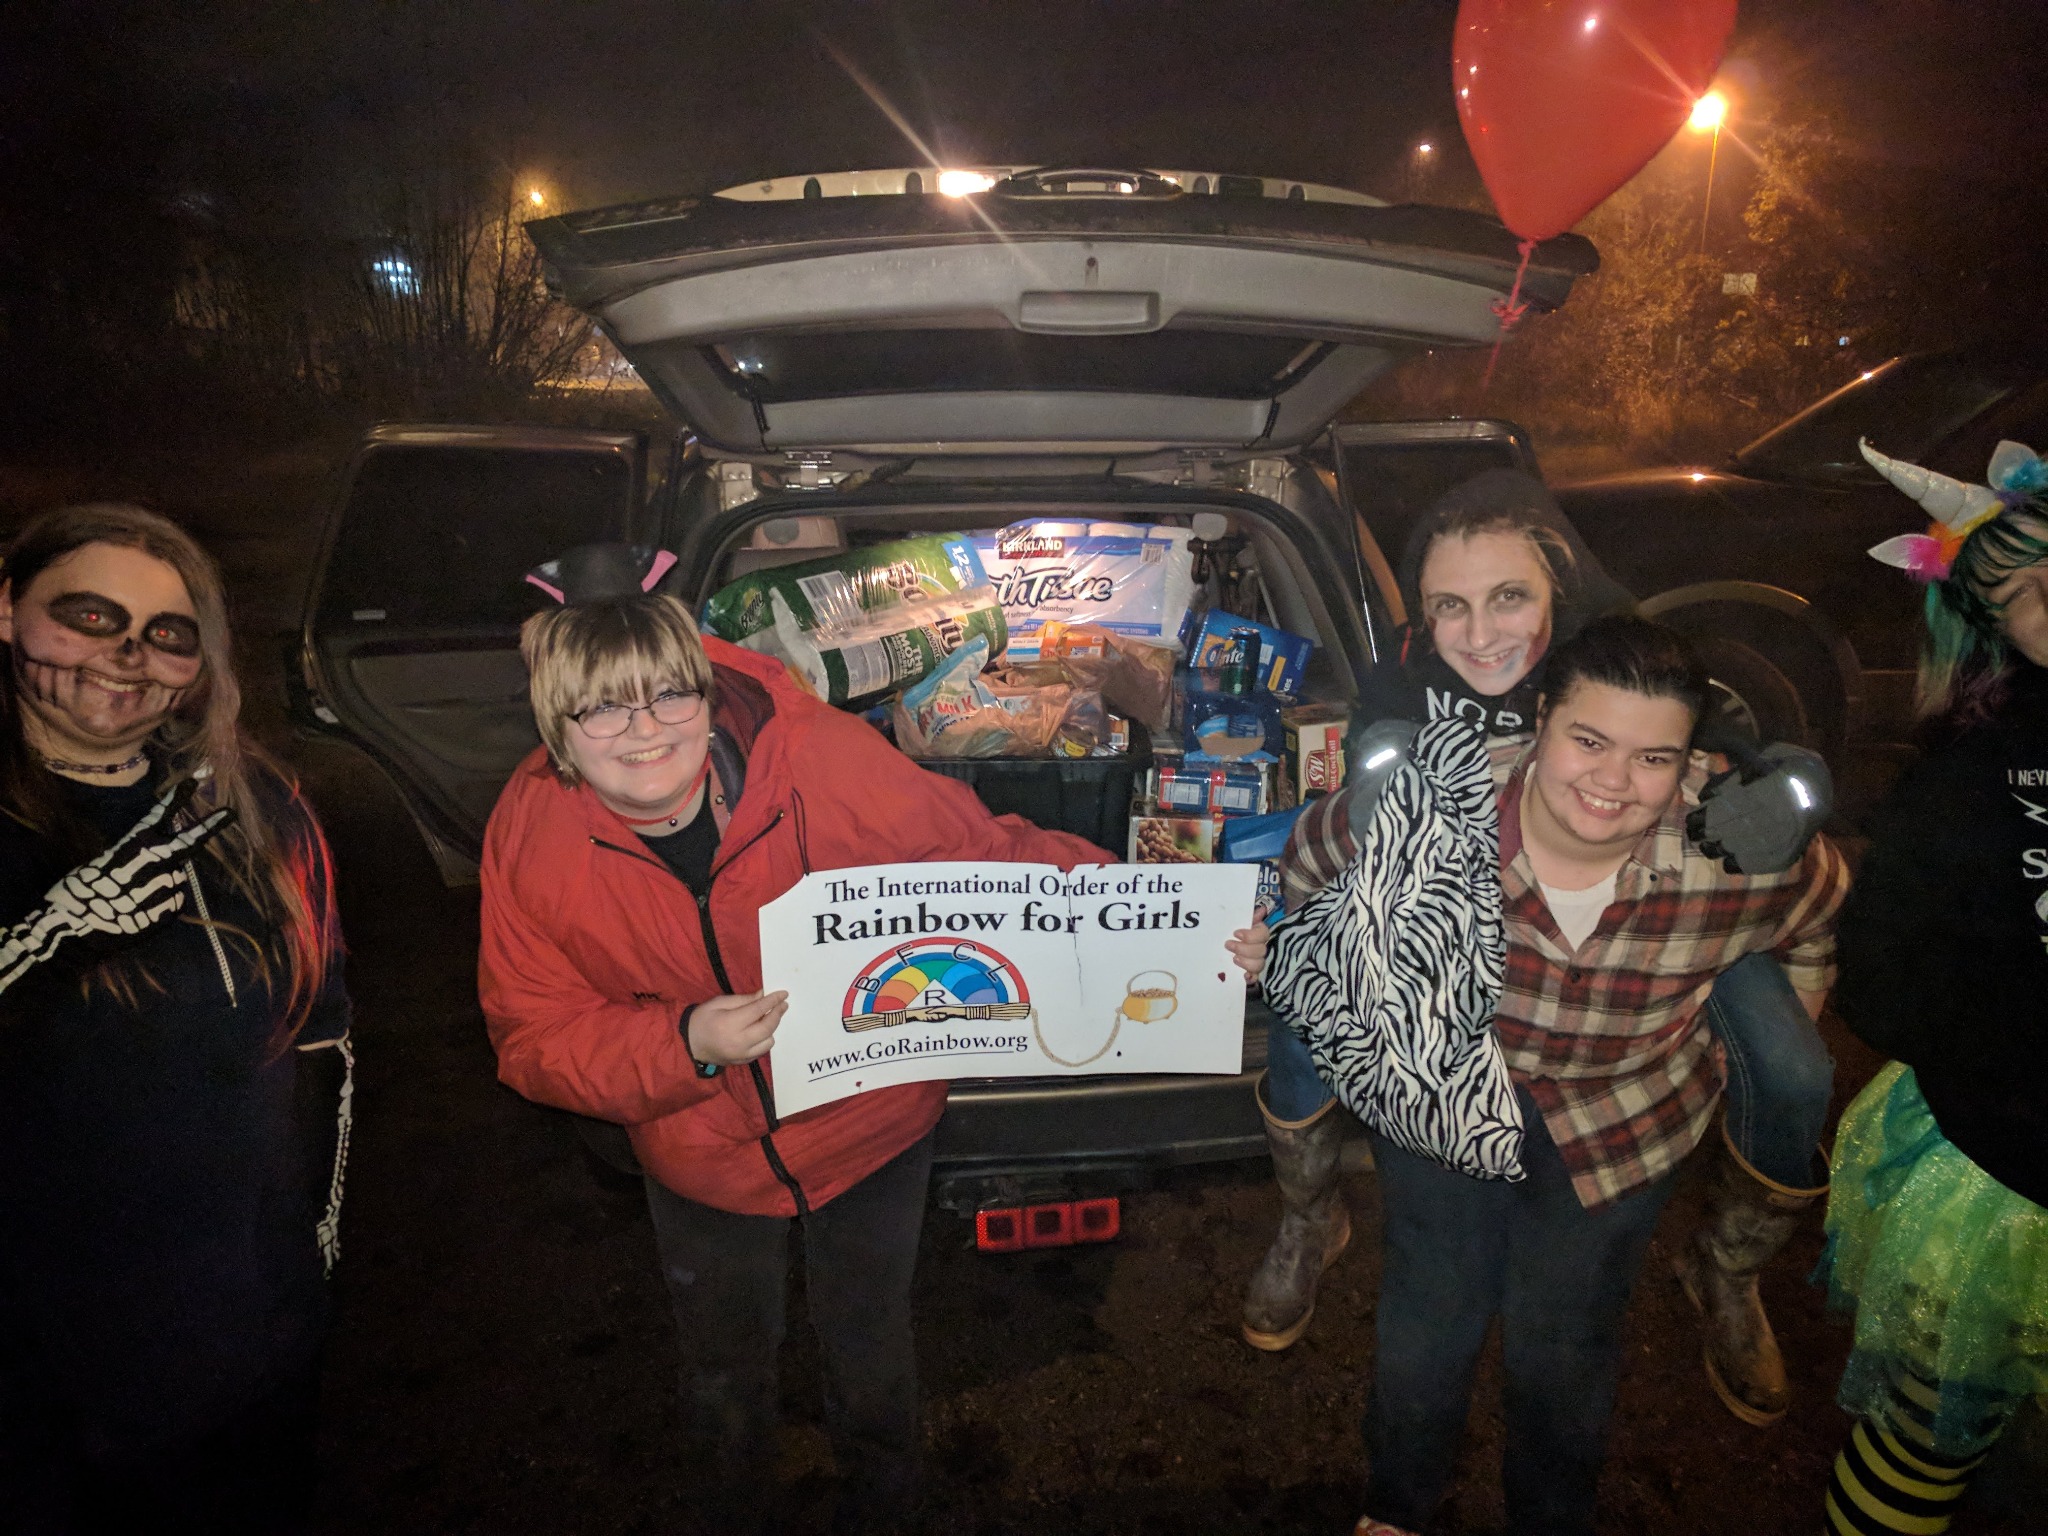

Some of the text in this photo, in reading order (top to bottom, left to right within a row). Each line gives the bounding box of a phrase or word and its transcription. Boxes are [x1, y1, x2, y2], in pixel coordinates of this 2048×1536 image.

[1002, 539, 1063, 554] KIRKLAND
[2018, 769, 2048, 786] NEV
[825, 873, 1183, 903] The International Order of the
[812, 899, 1200, 946] Rainbow for Girls
[924, 989, 947, 1006] R
[807, 1033, 1029, 1075] www.GoRainbow.org
